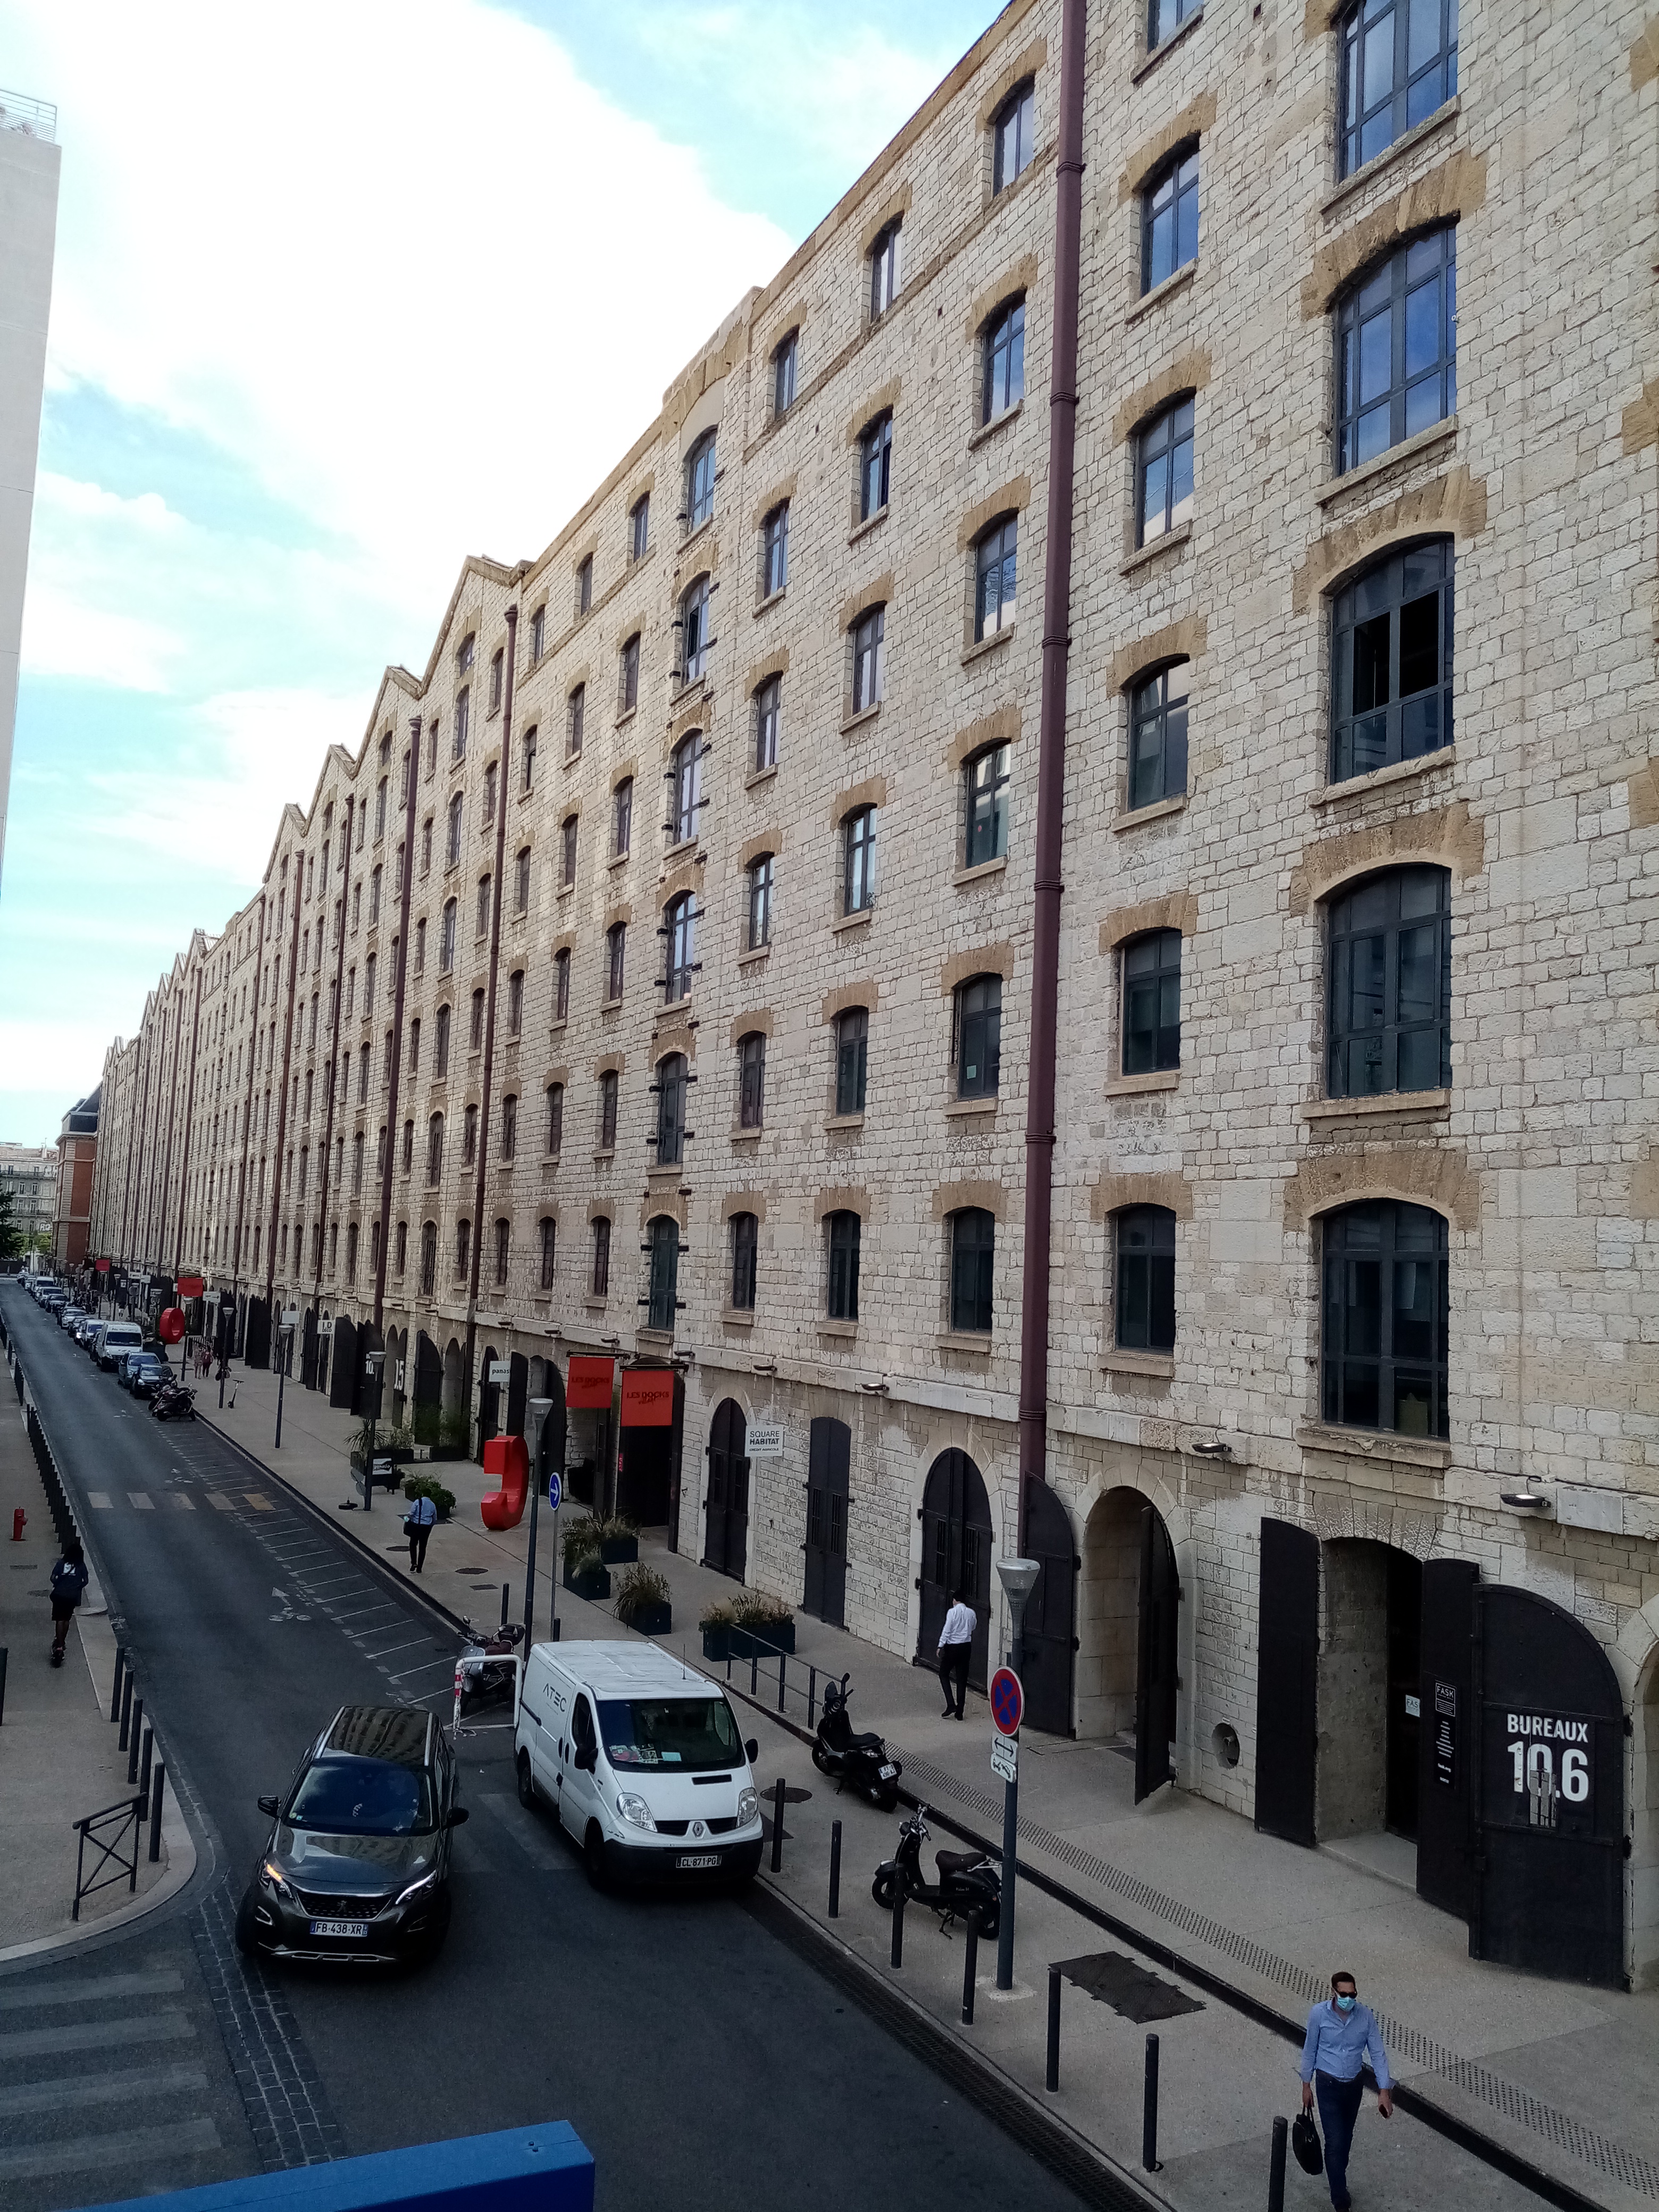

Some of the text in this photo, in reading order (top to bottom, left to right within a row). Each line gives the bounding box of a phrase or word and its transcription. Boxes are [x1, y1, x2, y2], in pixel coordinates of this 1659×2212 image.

[542, 1682, 567, 1712] ATEC
[1437, 1685, 1454, 1698] FASK
[1507, 1713, 1589, 1744] BUREAUX
[1507, 1740, 1589, 1802] 10.6
[316, 1923, 362, 1934] FB-438-XR
